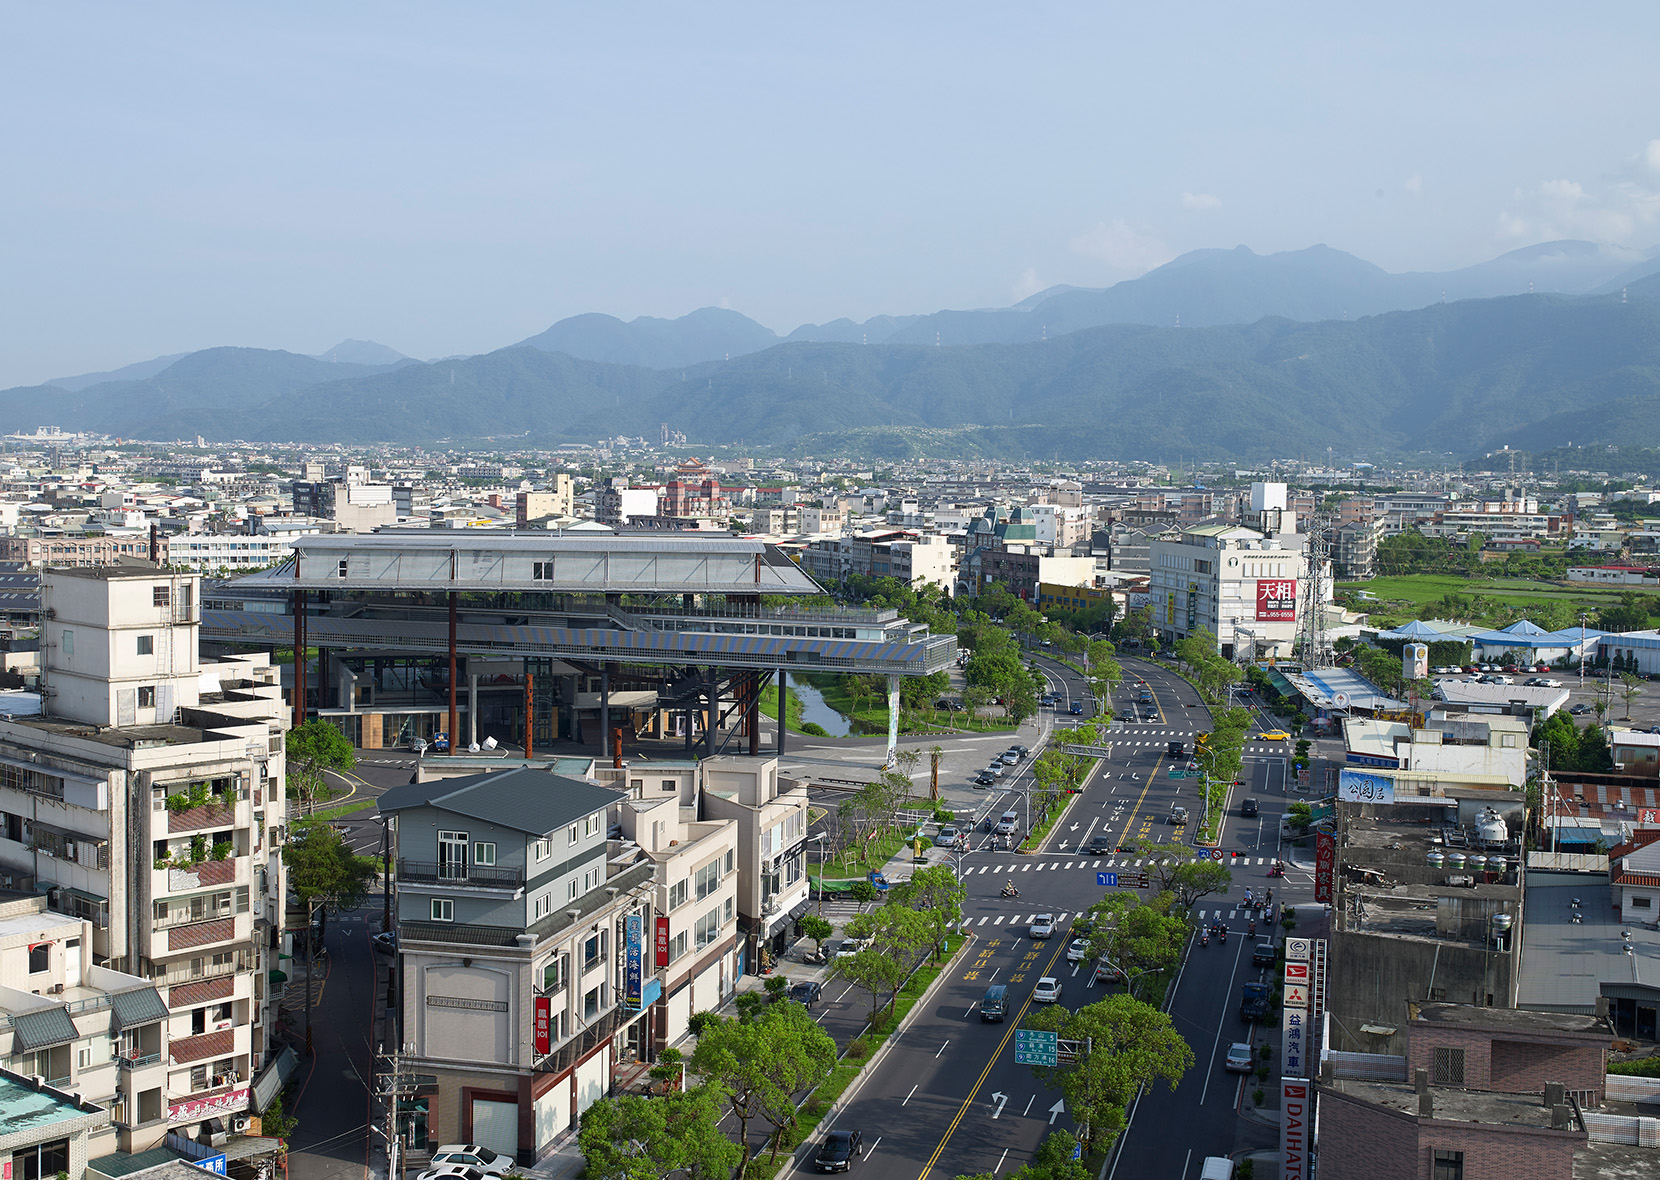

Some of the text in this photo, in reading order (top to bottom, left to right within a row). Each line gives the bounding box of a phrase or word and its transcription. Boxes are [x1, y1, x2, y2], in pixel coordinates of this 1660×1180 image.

[1259, 582, 1292, 600] 天相
[1288, 1014, 1301, 1068] 益鴻汽車
